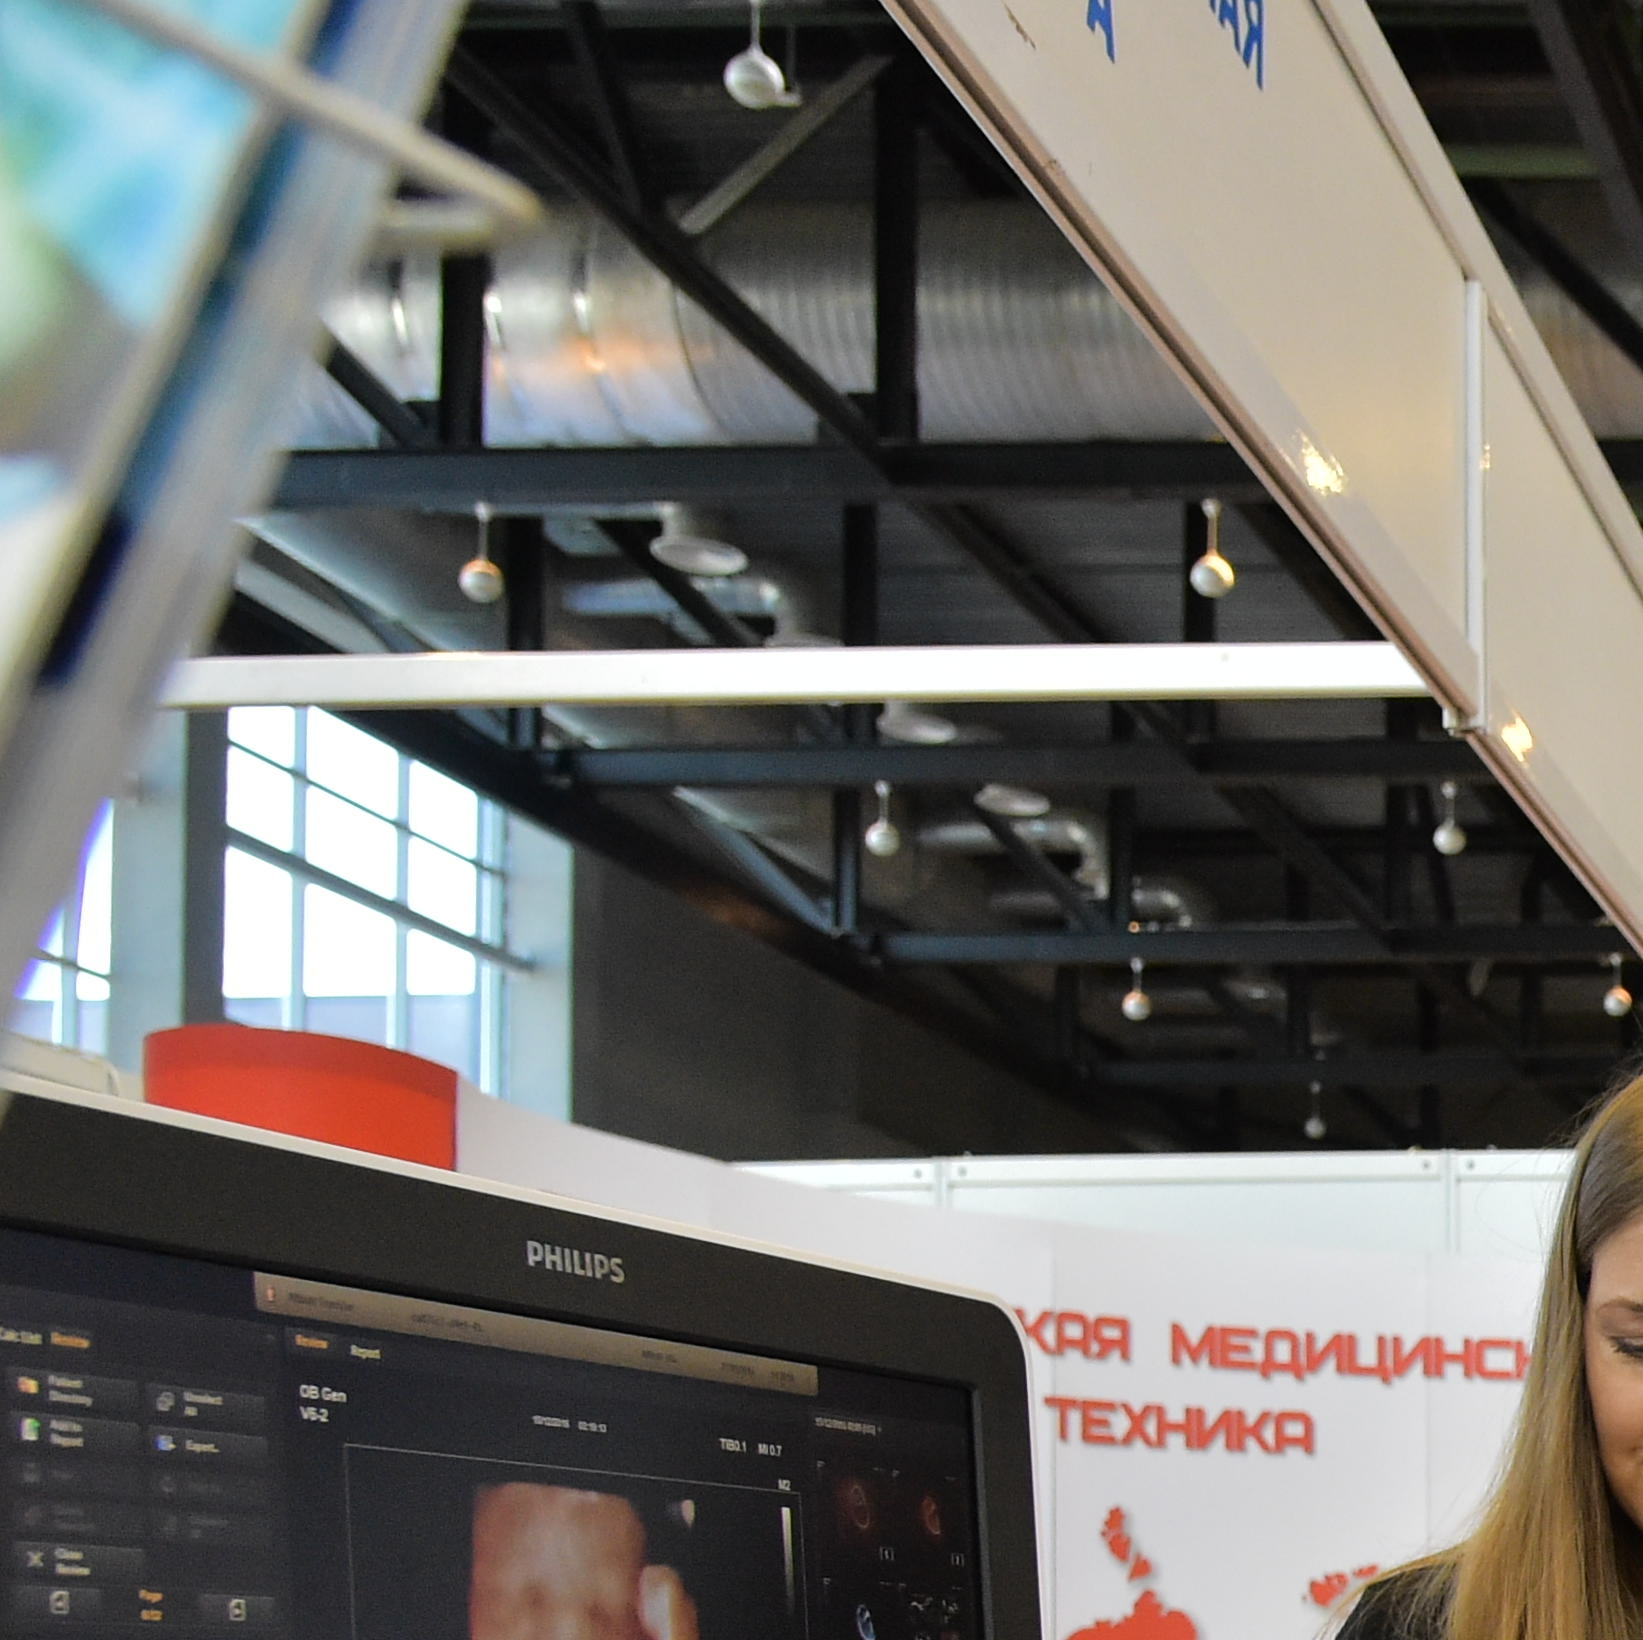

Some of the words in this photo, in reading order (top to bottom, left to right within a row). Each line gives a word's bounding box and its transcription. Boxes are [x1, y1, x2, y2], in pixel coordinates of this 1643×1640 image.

[526, 1241, 625, 1284] PHILIPS
[300, 1385, 320, 1400] OB
[322, 1388, 347, 1403] Gen
[1044, 1396, 1315, 1454] ТЕХНИКА
